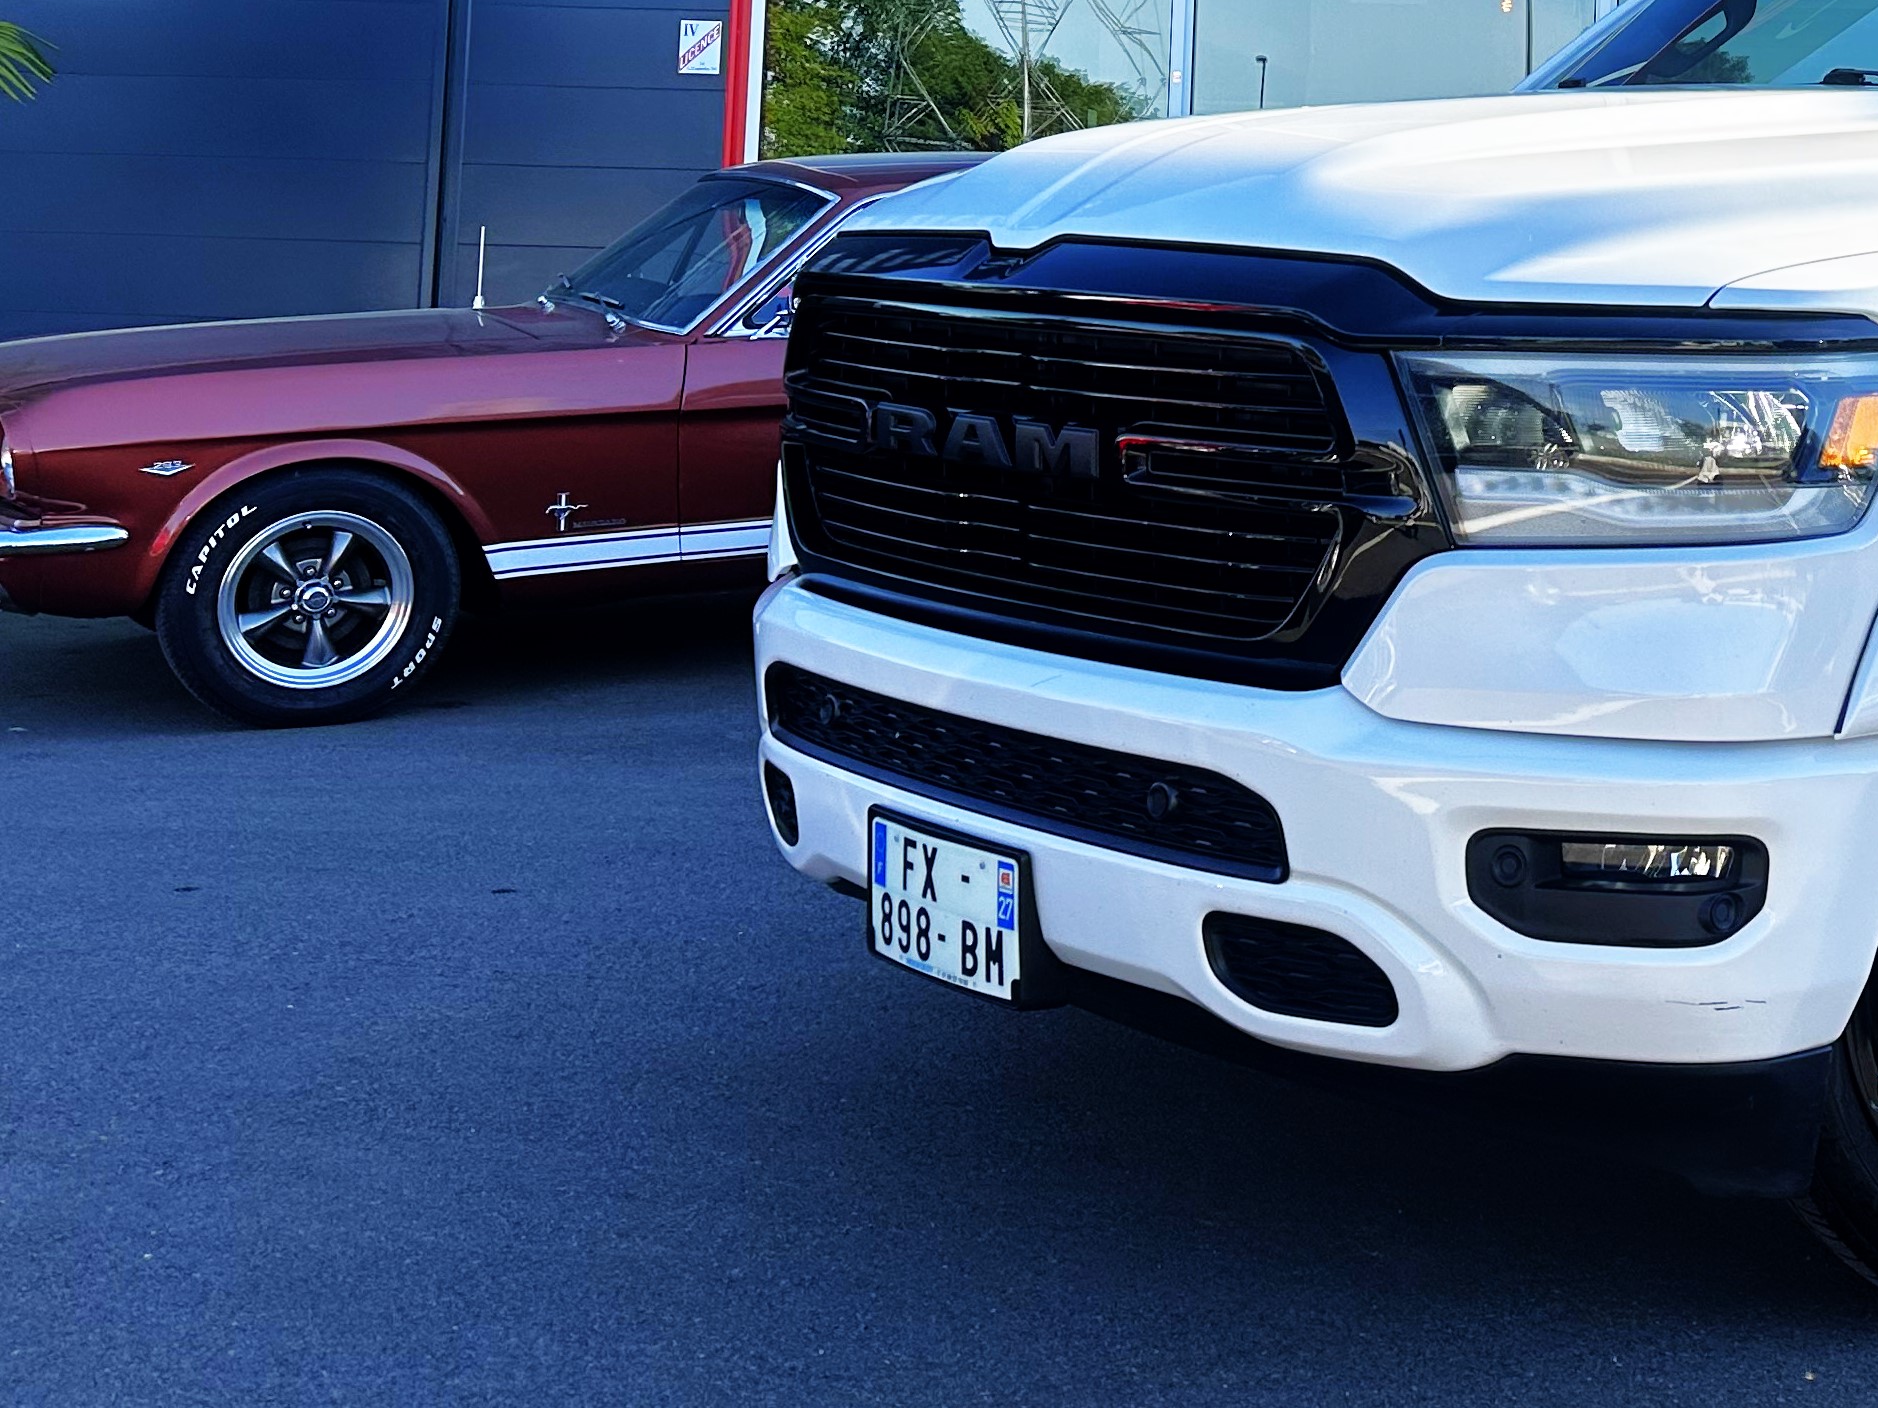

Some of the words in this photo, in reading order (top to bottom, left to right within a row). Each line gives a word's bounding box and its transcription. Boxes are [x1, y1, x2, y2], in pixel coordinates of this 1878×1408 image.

[680, 25, 720, 69] LICENCE
[683, 23, 700, 37] IV
[873, 401, 1100, 479] RAM
[186, 504, 258, 595] CAPITOL
[390, 615, 443, 690] SPORT
[902, 836, 938, 903] FX
[998, 897, 1013, 921] 27
